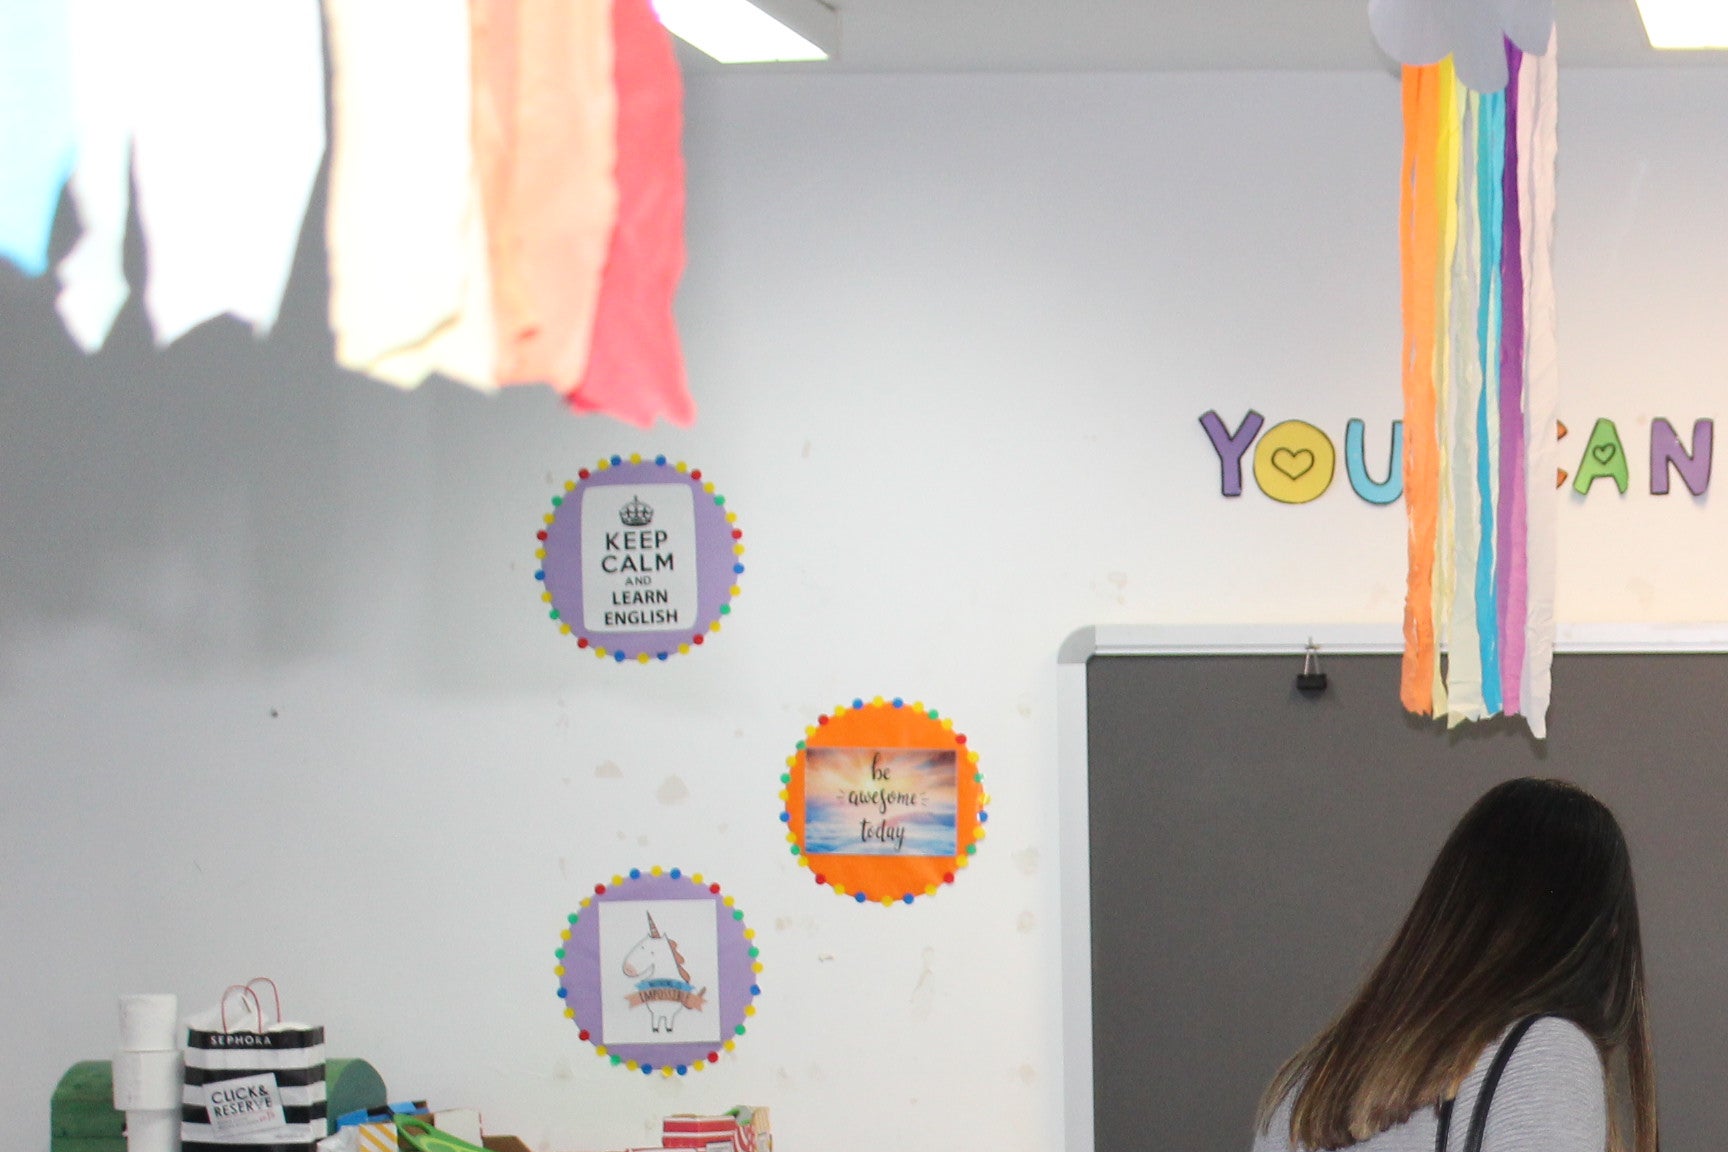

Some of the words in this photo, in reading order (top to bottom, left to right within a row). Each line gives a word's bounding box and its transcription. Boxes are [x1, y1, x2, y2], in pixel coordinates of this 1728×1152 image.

[1199, 409, 1403, 504] YOU
[1557, 417, 1714, 497] AN
[605, 529, 668, 551] KEEP
[601, 552, 675, 574] CALM
[624, 575, 653, 586] AND
[612, 588, 668, 605] LEARN
[604, 608, 678, 626] ENGLISH
[871, 751, 890, 780] be
[848, 787, 918, 814] awesome
[860, 817, 905, 851] today
[210, 1034, 273, 1046] SEPHORA
[213, 1096, 274, 1118] RESERVE
